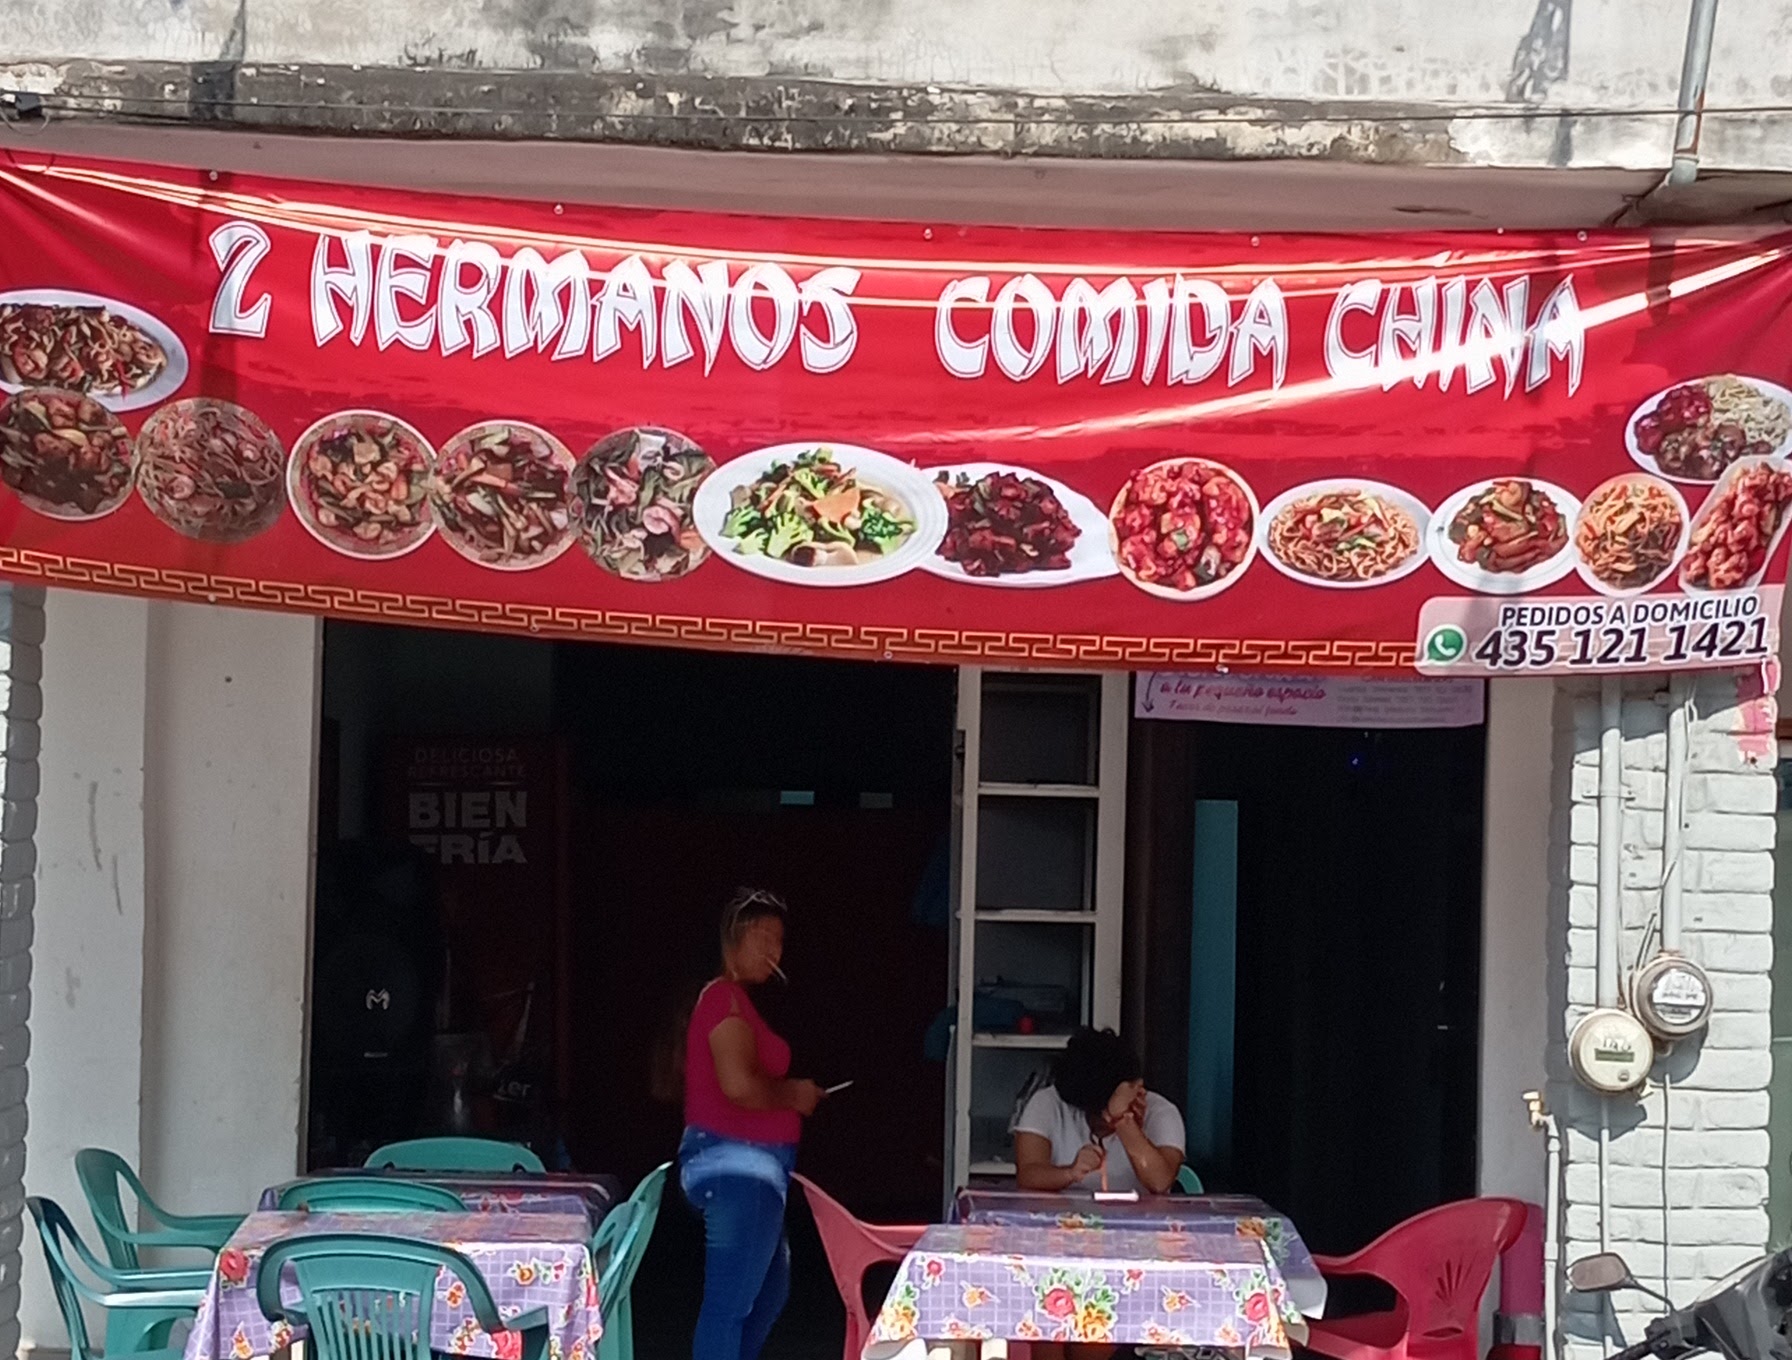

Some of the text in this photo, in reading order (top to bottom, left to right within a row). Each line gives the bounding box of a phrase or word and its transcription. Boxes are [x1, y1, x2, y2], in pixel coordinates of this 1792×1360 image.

[208, 220, 1586, 401] 2 HERMANOS COMIDA CHINA
[1501, 595, 1759, 627] PEDIDOS A DOMICILIO
[1474, 616, 1768, 667] 435 121 1421
[409, 791, 528, 828] BIEN
